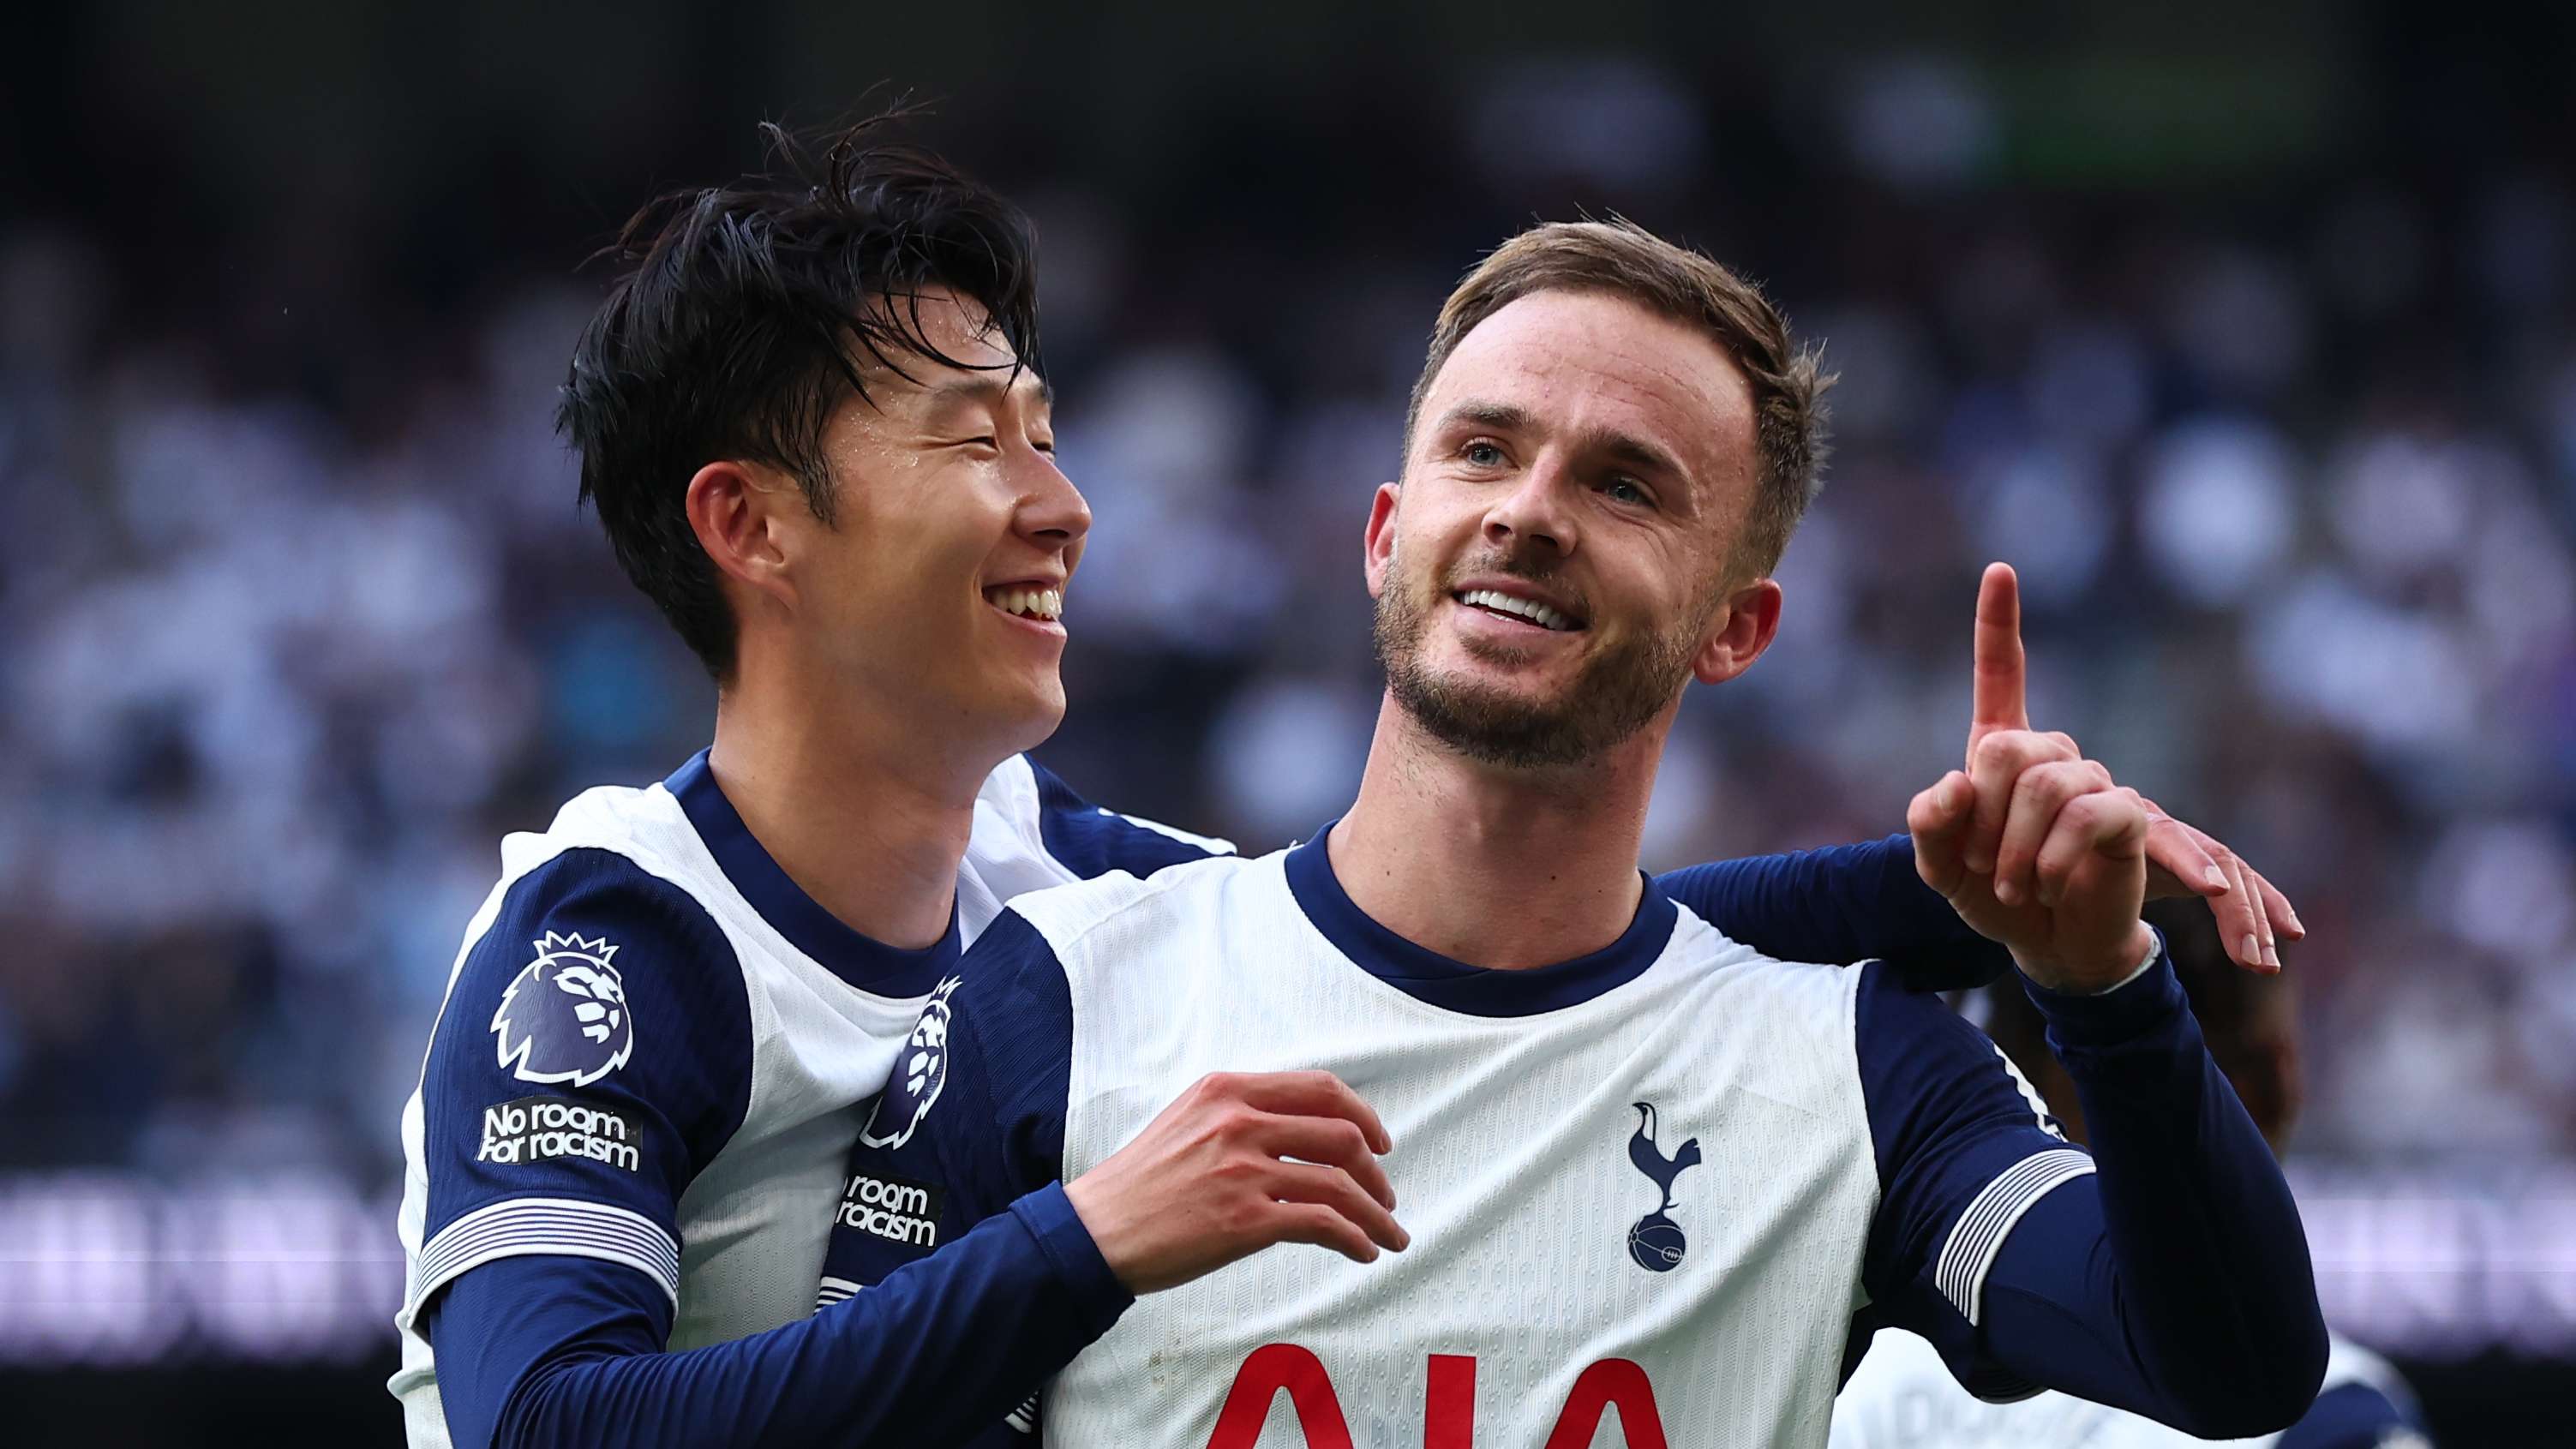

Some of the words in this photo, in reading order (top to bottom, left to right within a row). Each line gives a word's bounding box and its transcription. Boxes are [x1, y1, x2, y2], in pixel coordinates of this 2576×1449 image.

[484, 1105, 526, 1139] No
[531, 1104, 626, 1140] room
[530, 1132, 639, 1171] racism
[848, 1176, 928, 1215] room
[836, 1201, 936, 1247] racism
